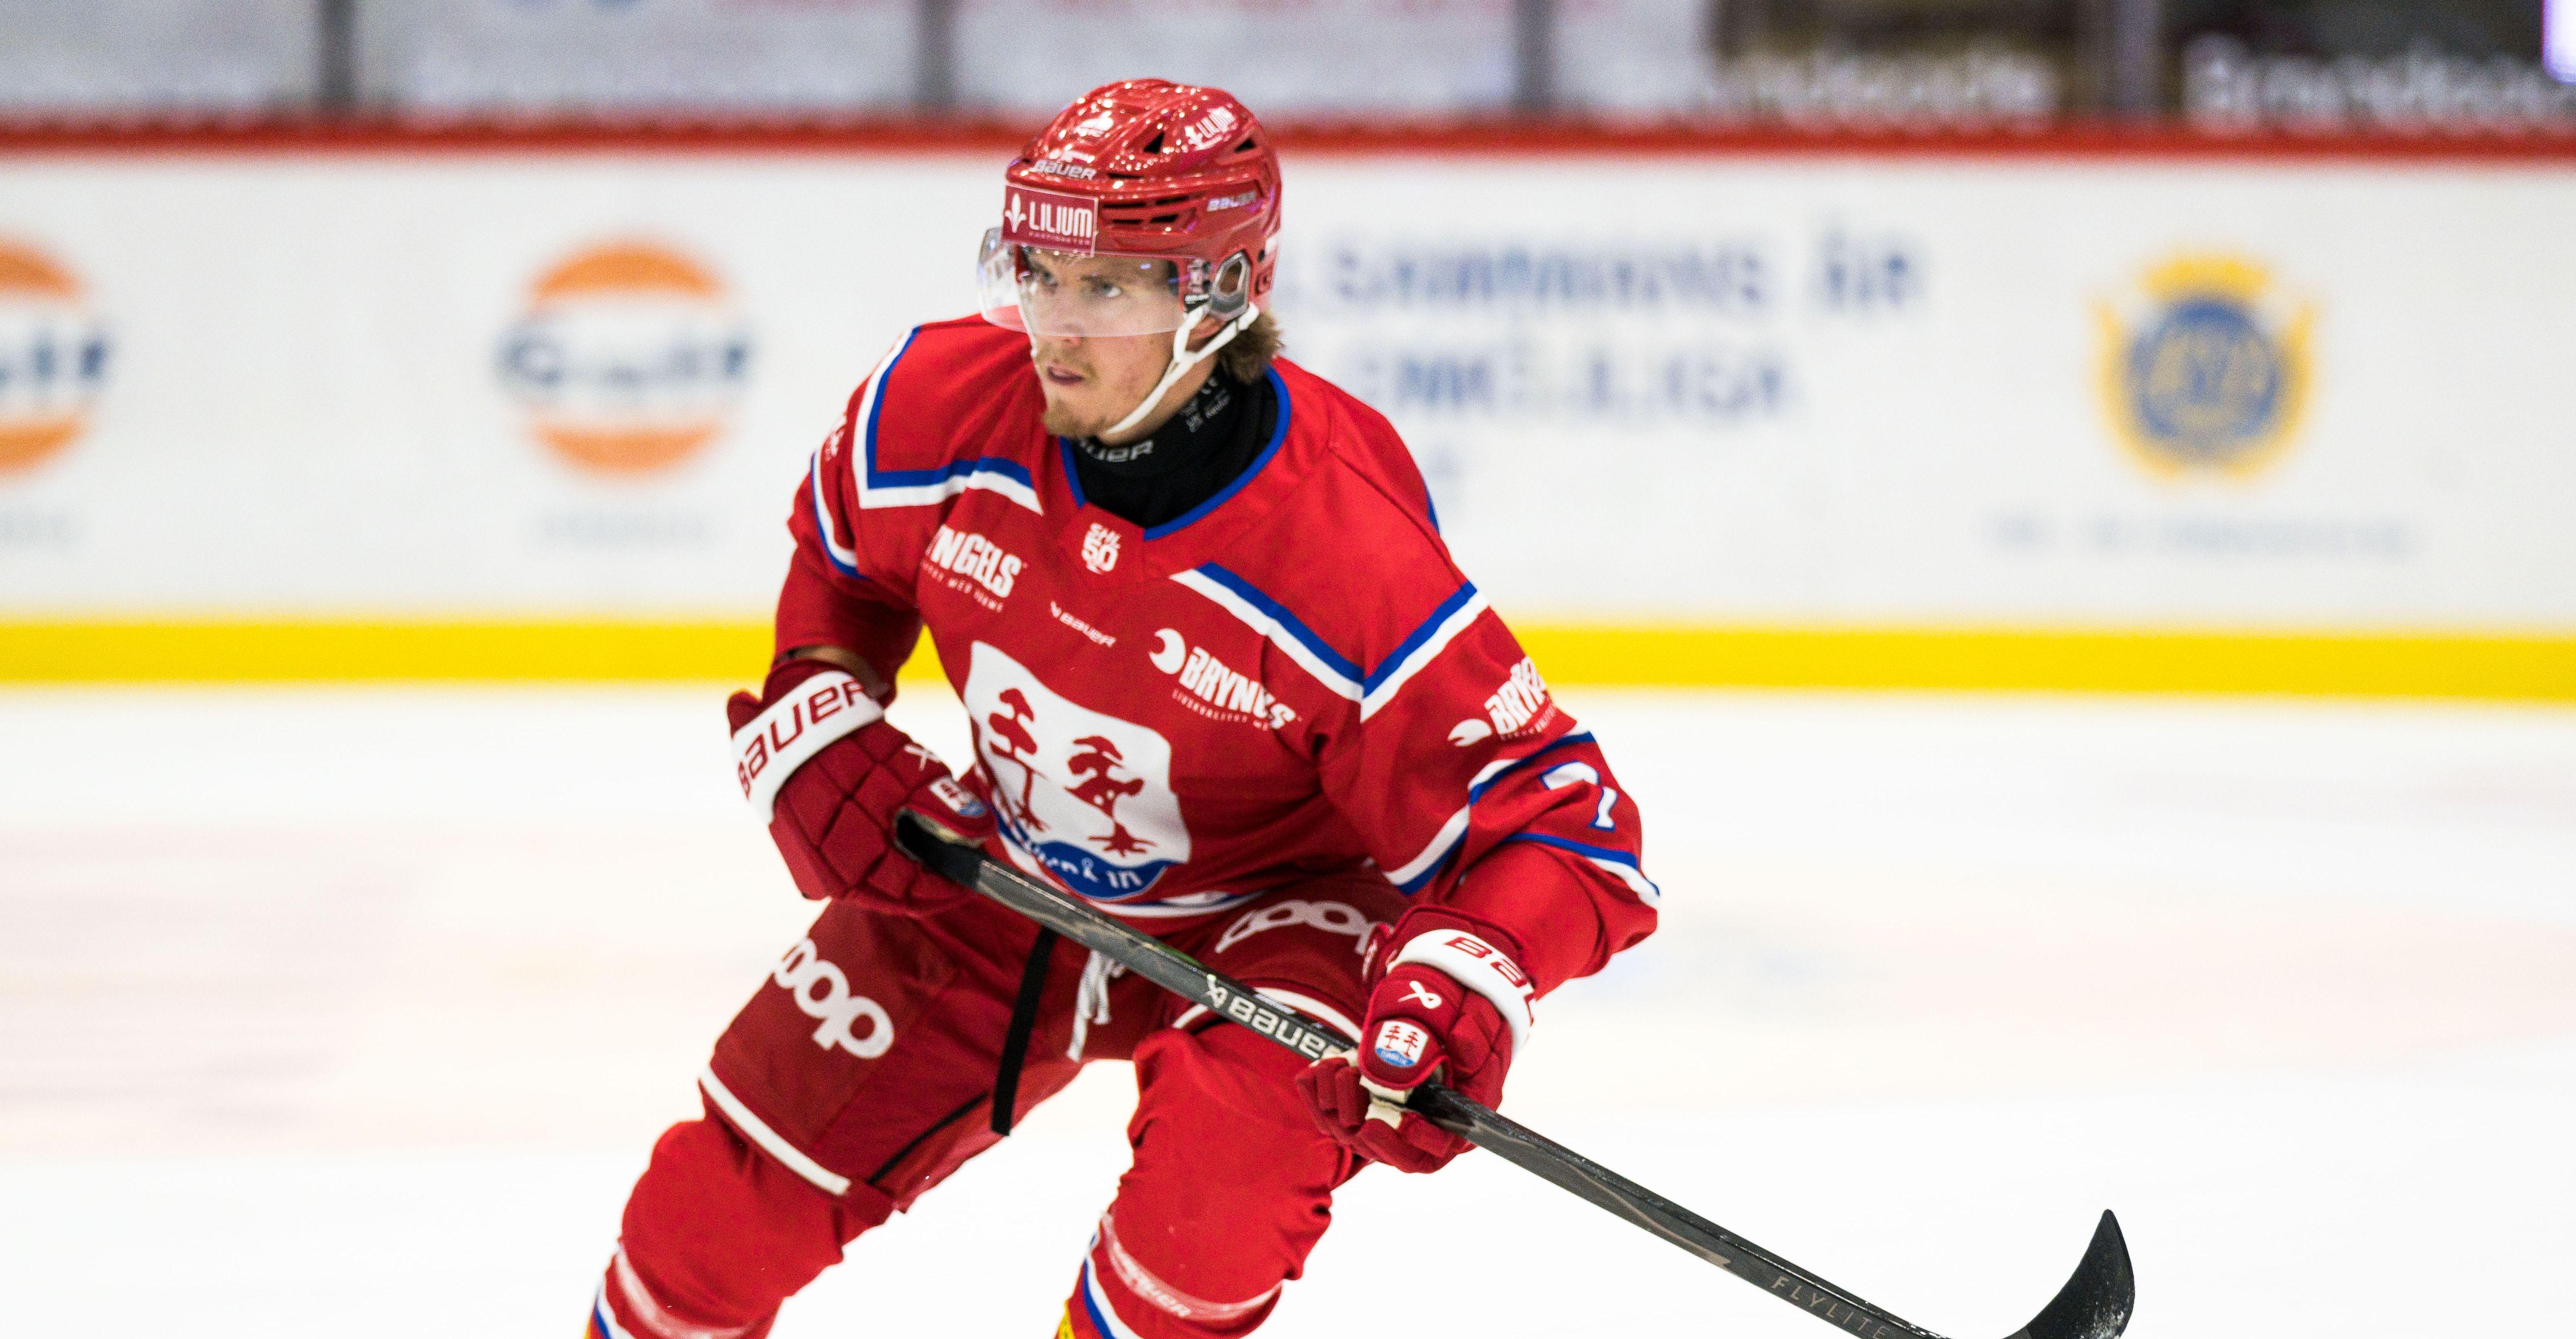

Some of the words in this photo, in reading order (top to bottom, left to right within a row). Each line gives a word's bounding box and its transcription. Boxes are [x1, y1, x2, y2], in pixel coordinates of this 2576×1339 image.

[1029, 201, 1094, 238] LILIUM
[775, 937, 895, 1059] oop
[1229, 996, 1330, 1060] BAUE
[1771, 1275, 1891, 1339] FLYLITE
